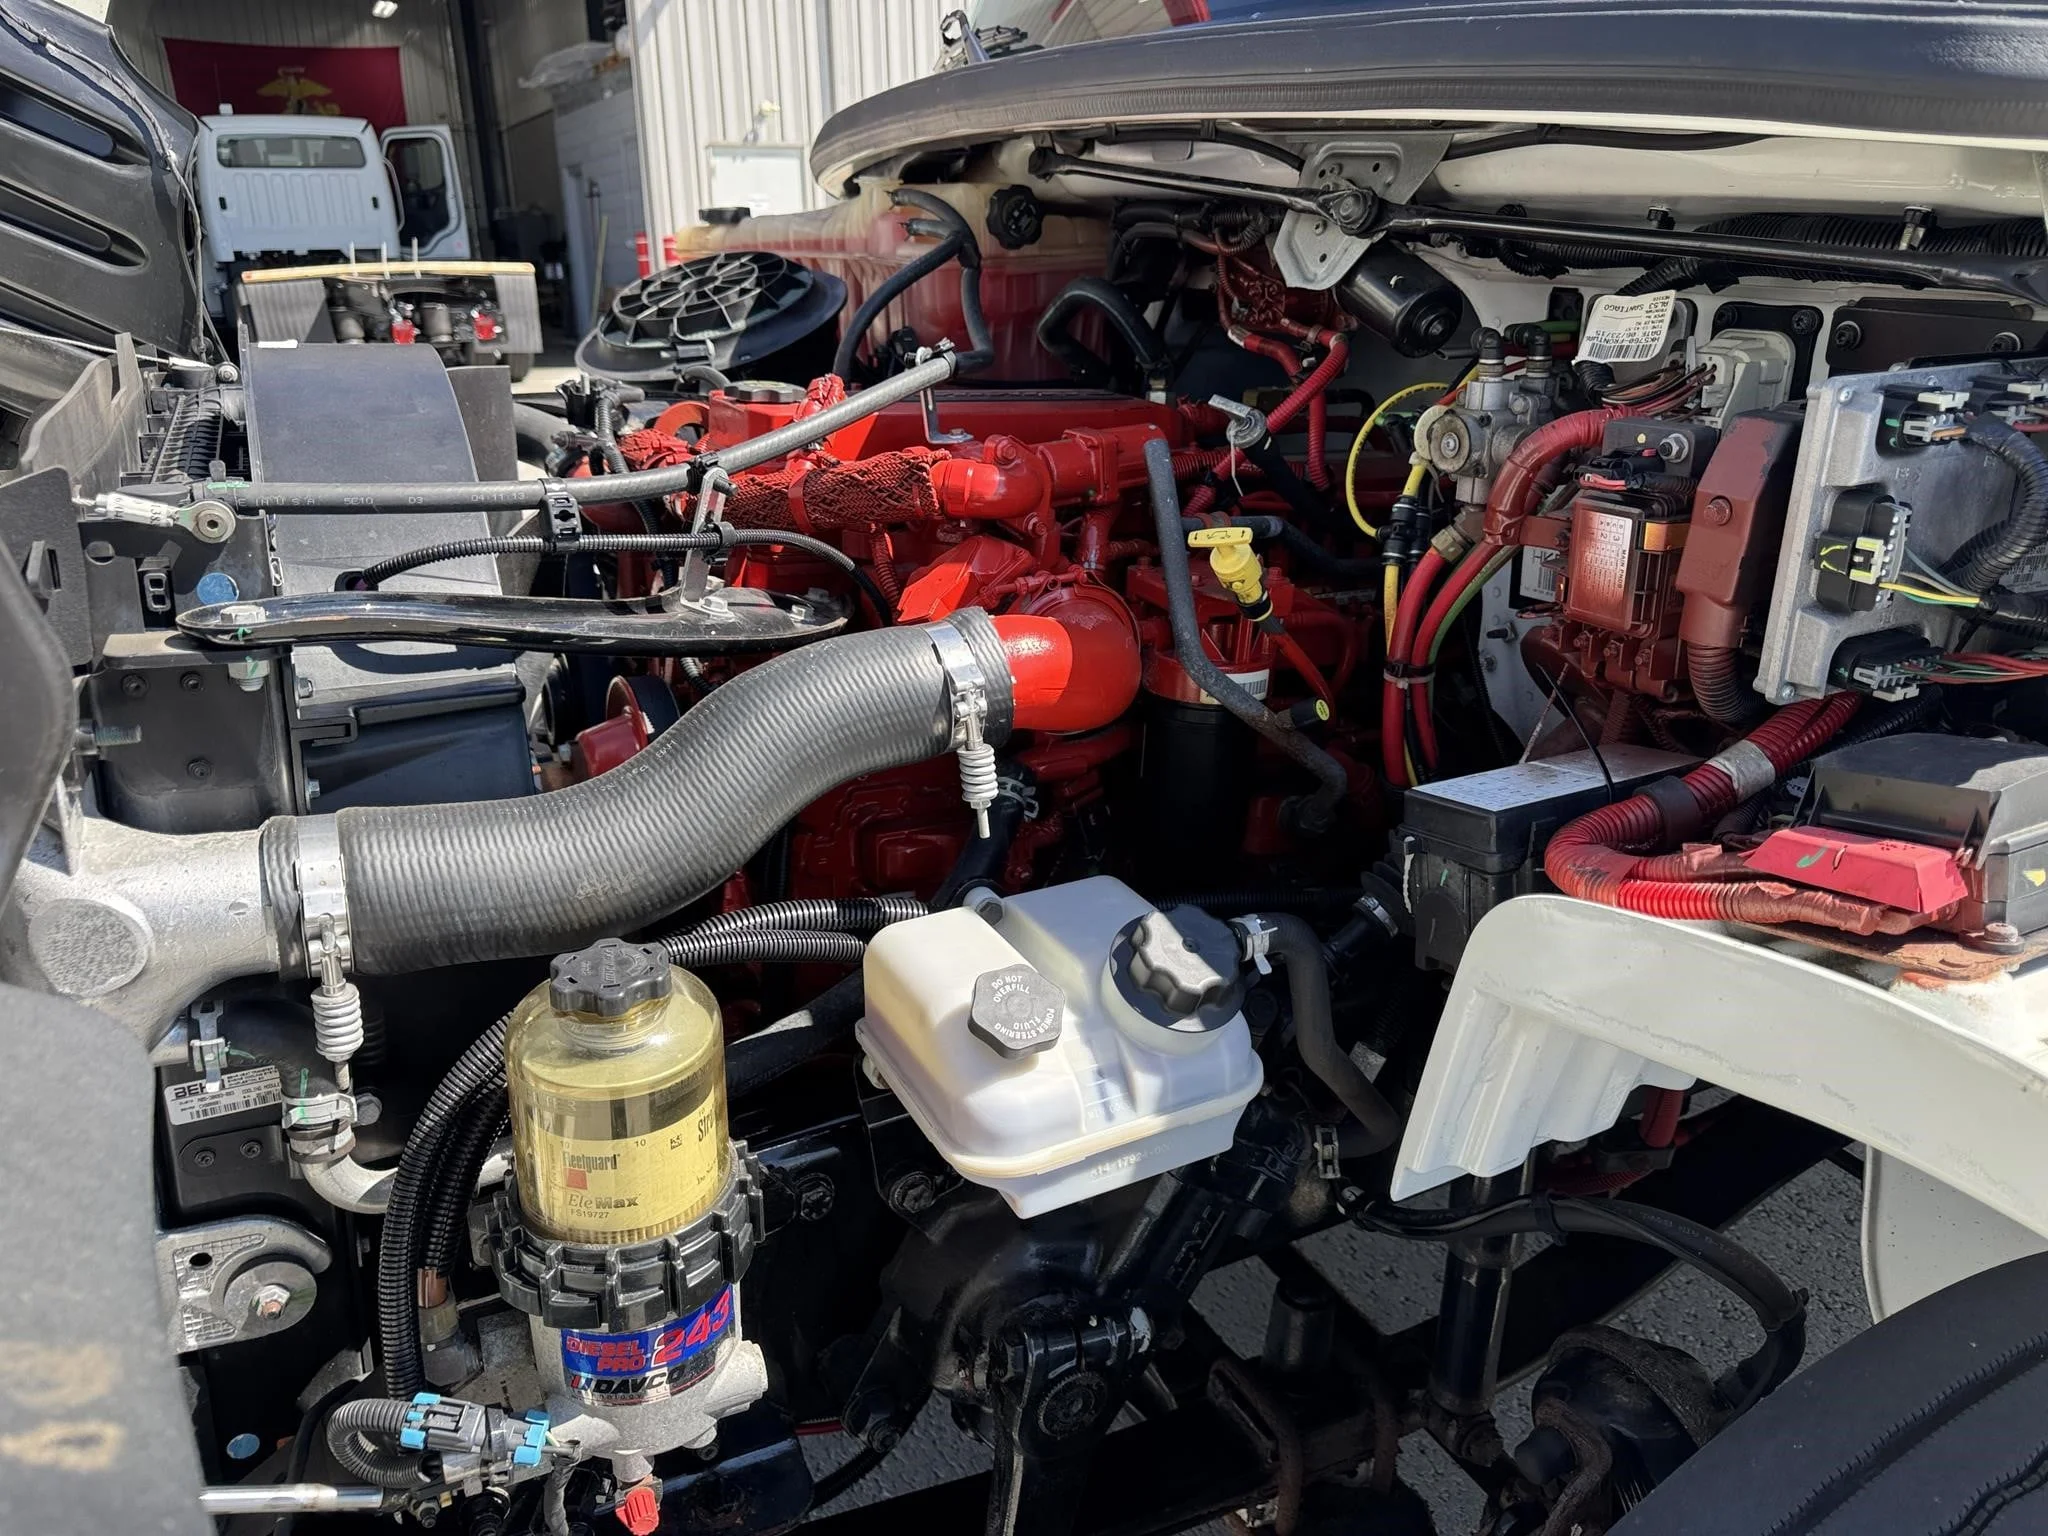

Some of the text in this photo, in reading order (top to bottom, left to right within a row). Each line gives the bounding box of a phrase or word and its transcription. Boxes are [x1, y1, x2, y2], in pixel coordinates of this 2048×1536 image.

[1604, 304, 1645, 312] SANTIAGO
[991, 975, 1023, 990] DO NOT
[993, 984, 1030, 1003] OVERFILL
[994, 1008, 1055, 1040] POWER STEERING
[1013, 1016, 1042, 1030] FLUID
[570, 1210, 610, 1219] FS19727
[596, 1288, 732, 1372] PRO 243
[566, 1336, 645, 1356] DIESEL
[593, 1364, 686, 1395] DAVCO
